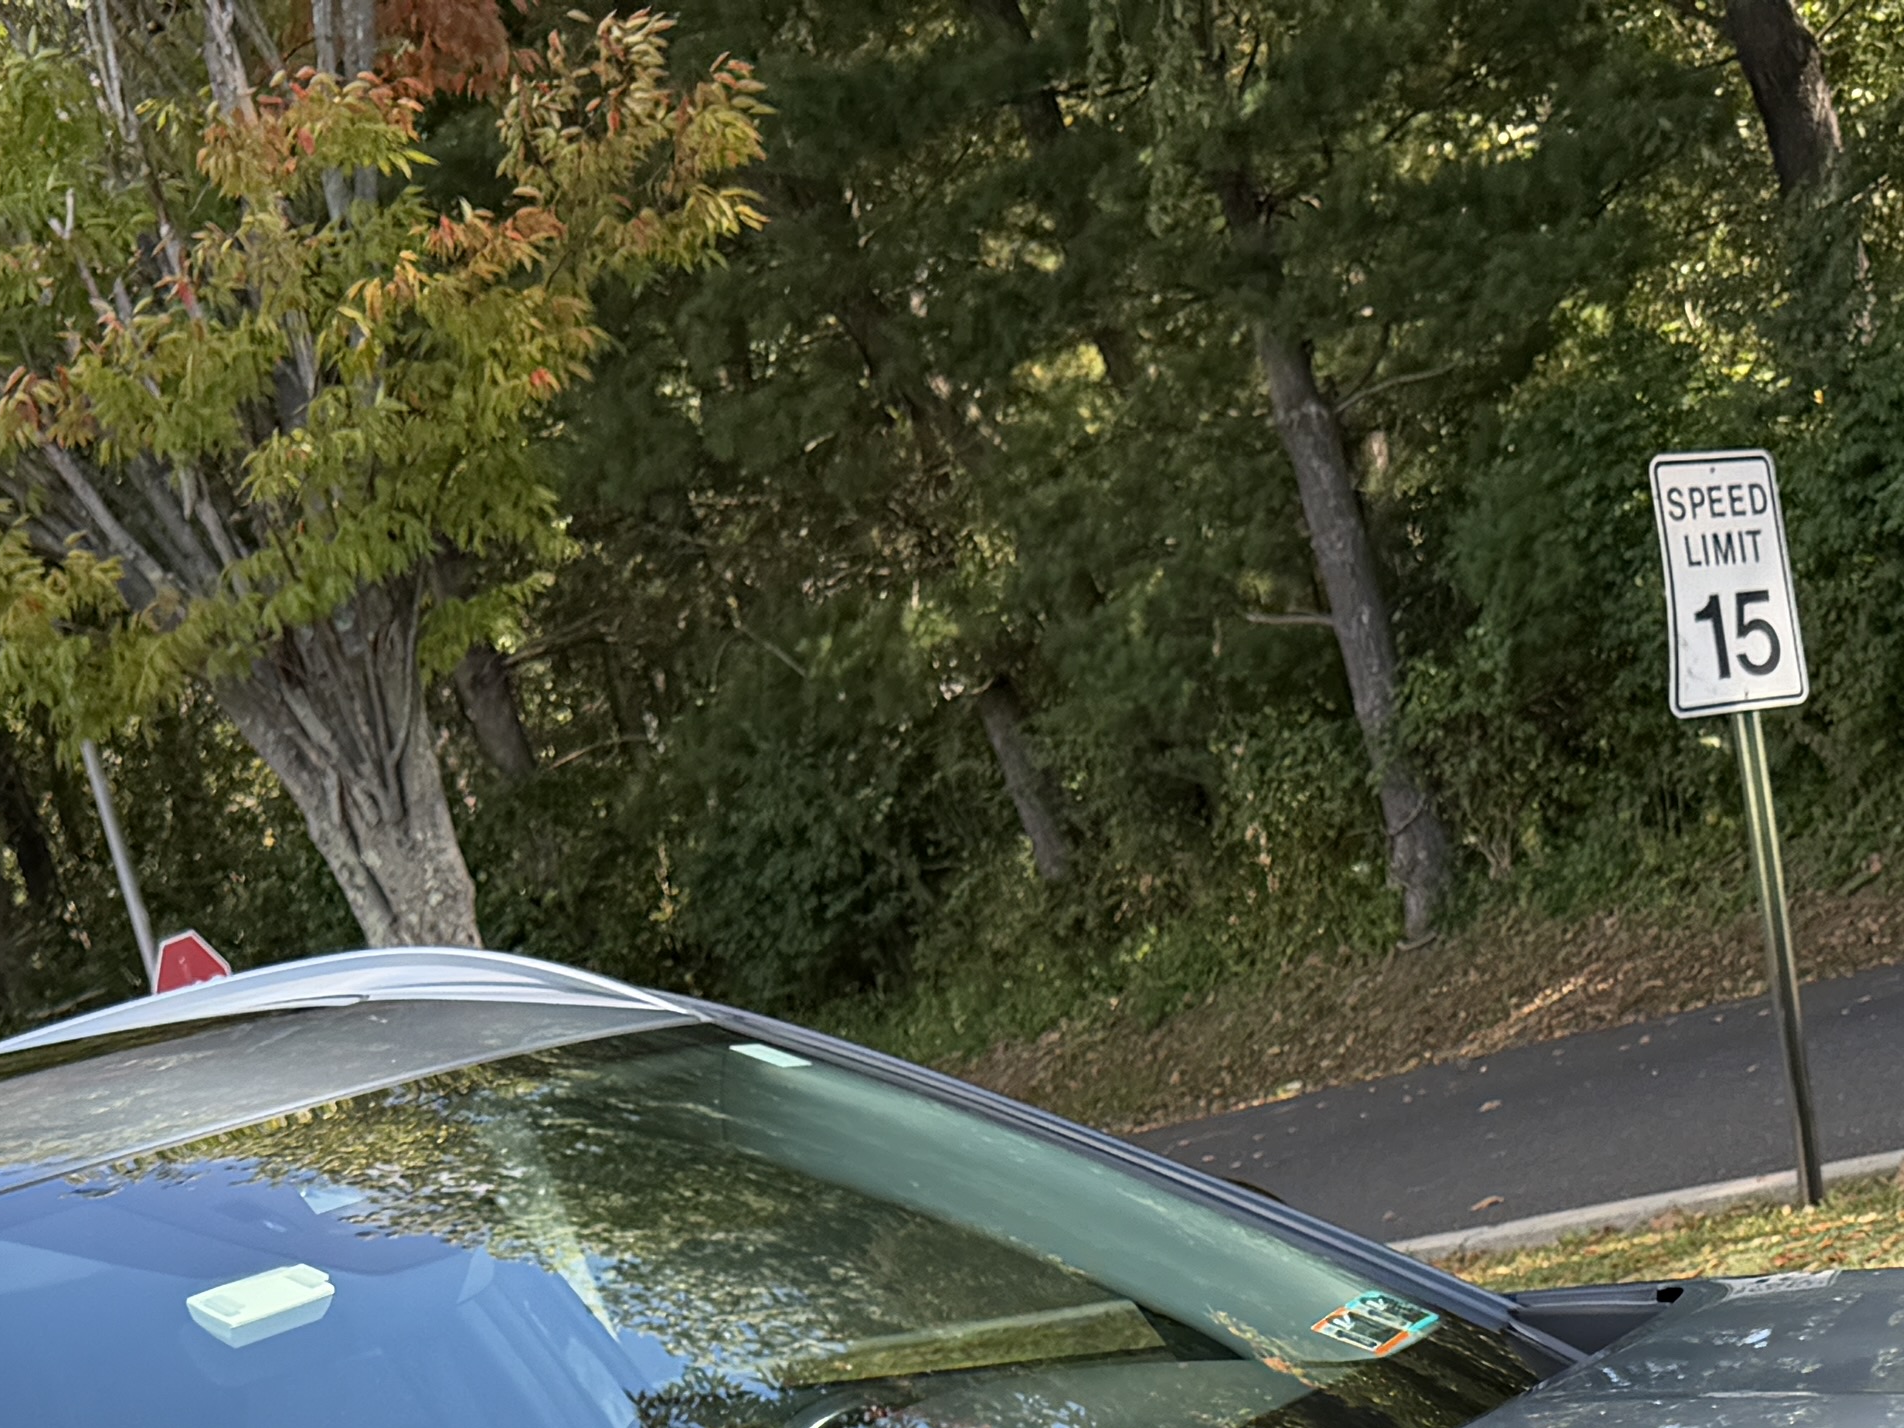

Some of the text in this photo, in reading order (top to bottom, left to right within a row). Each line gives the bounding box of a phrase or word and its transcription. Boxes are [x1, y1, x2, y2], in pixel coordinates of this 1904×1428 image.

[1667, 482, 1768, 521] SPEED
[1684, 529, 1762, 567] LIMIT
[1693, 589, 1782, 680] 15
